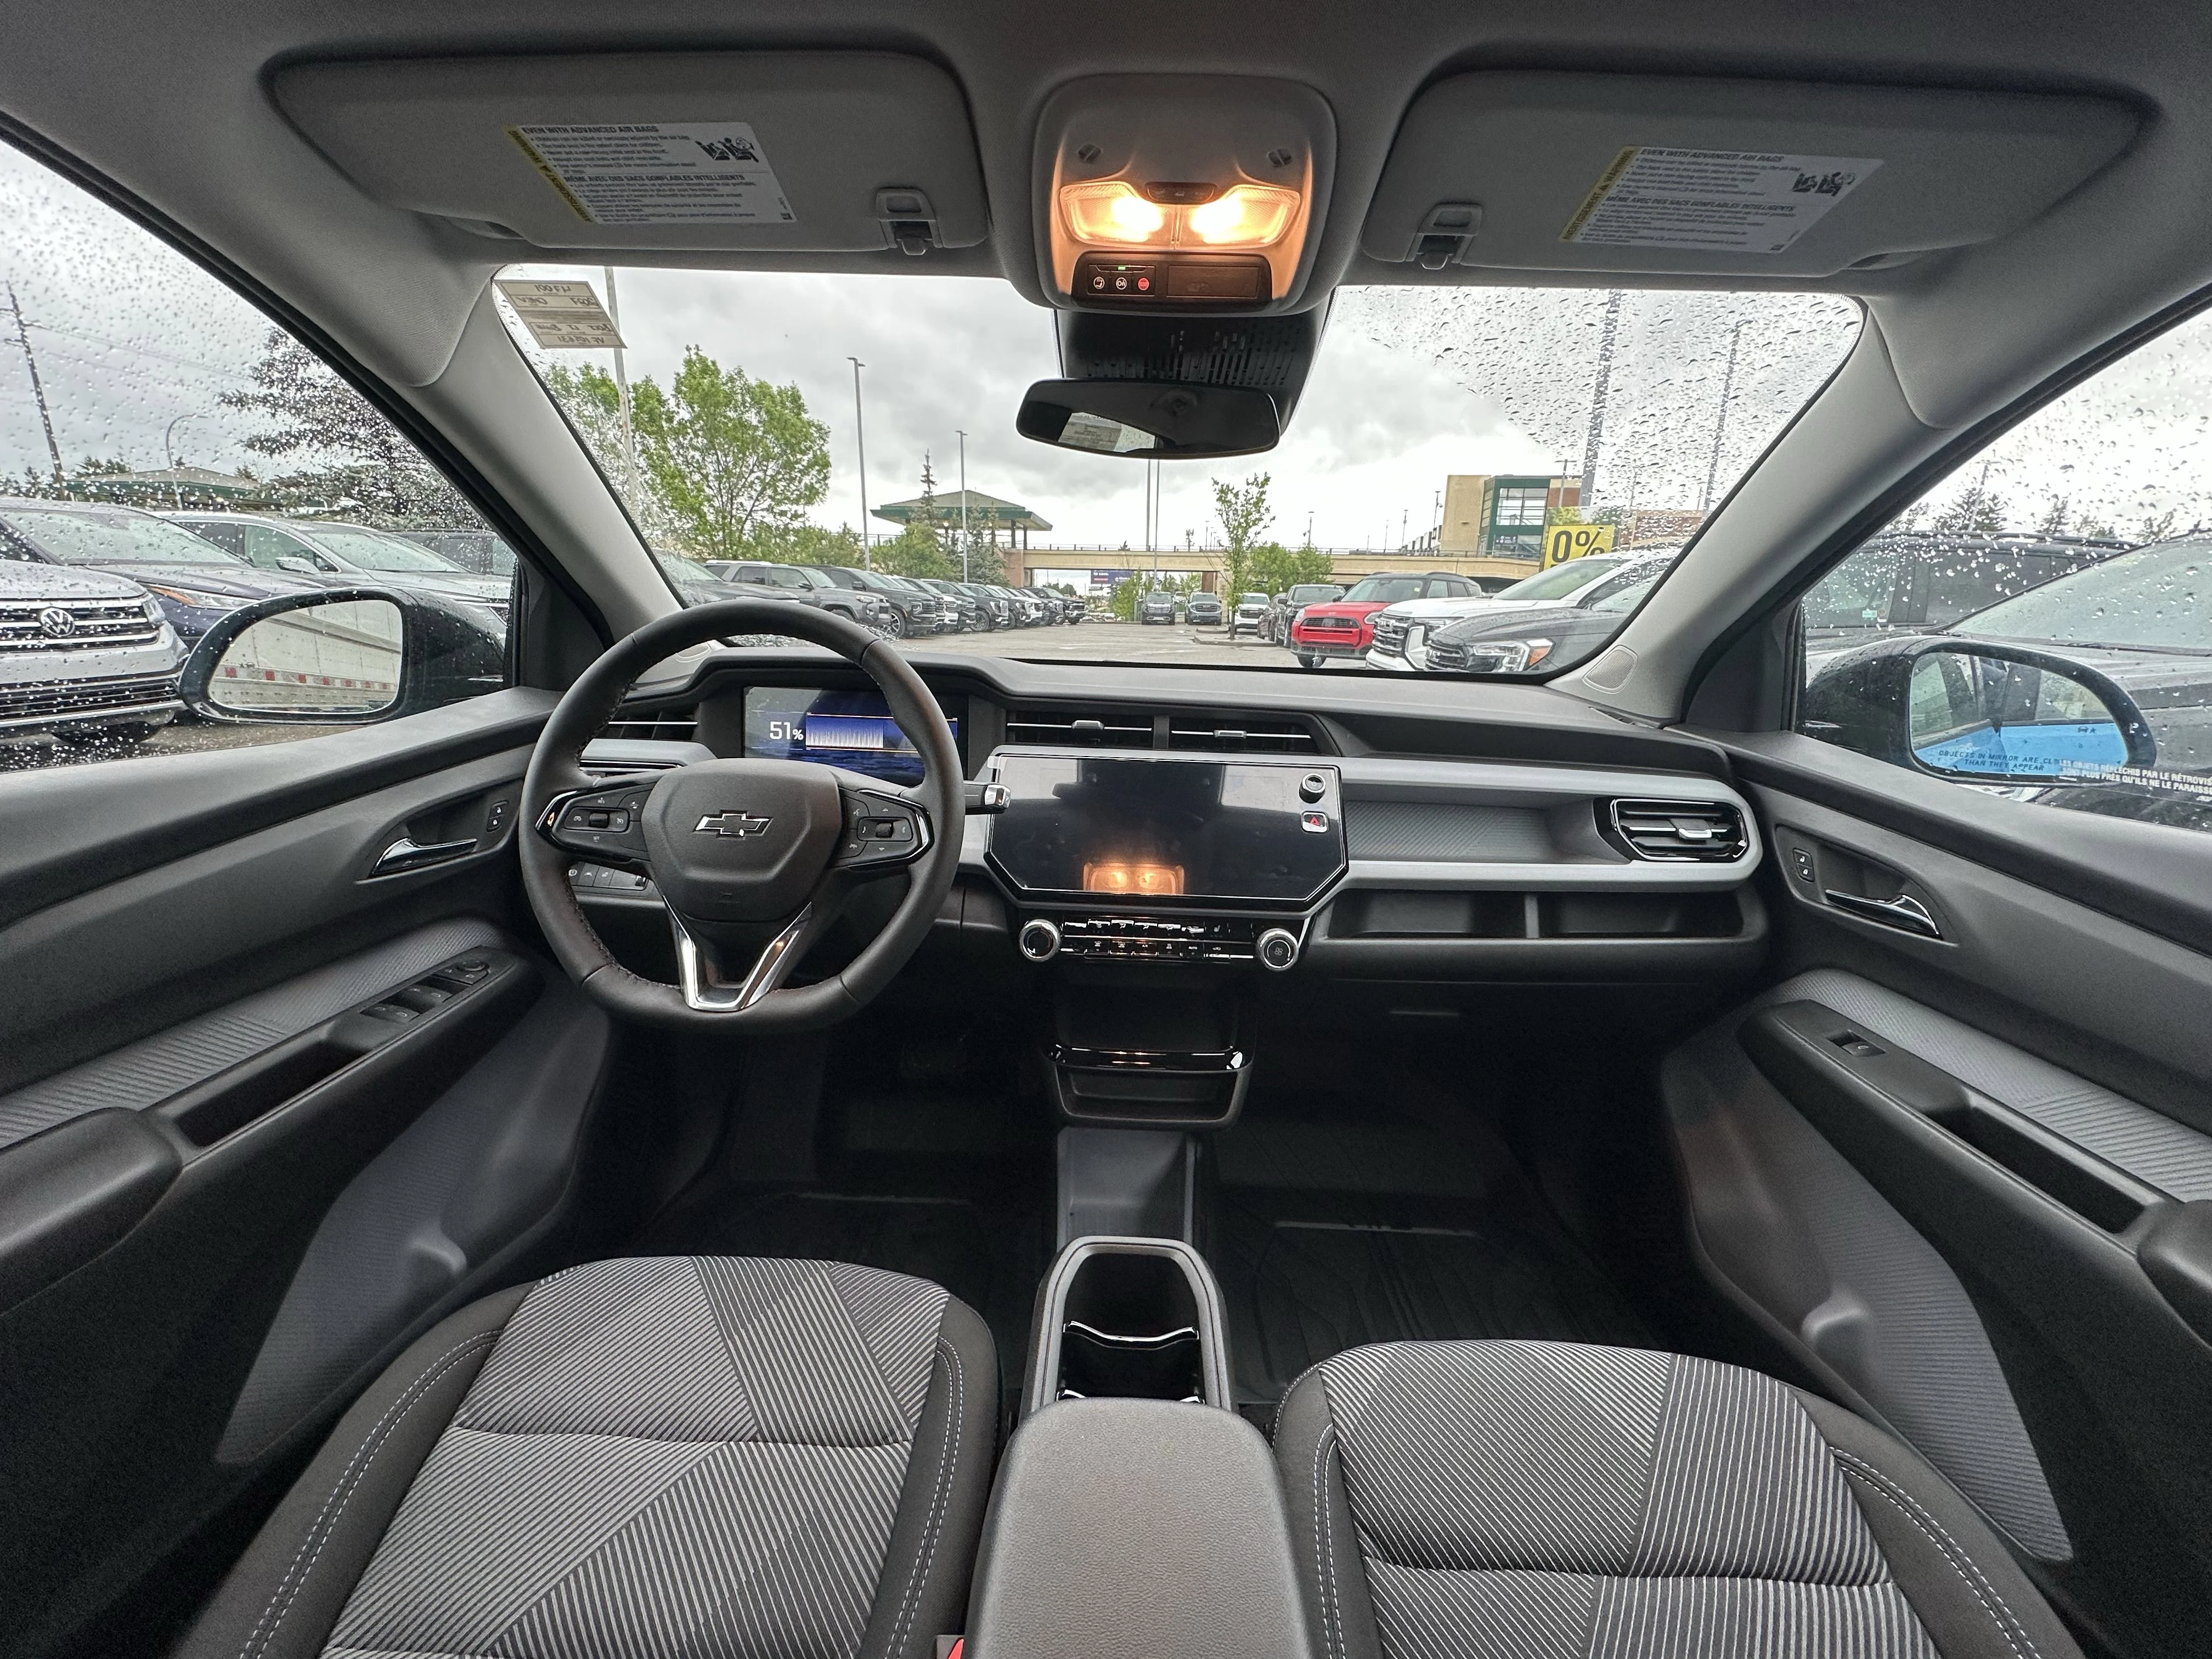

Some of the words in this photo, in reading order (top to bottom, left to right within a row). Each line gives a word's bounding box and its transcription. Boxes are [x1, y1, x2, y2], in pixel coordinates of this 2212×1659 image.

[1689, 151, 1741, 160] ADVANCED
[1551, 527, 1605, 563] 0%
[769, 721, 804, 741] 51%
[1939, 750, 1974, 758] OBJECTS
[2102, 772, 2120, 782] PRÈS
[2142, 770, 2158, 778] PAR
[2160, 772, 2170, 780] LE
